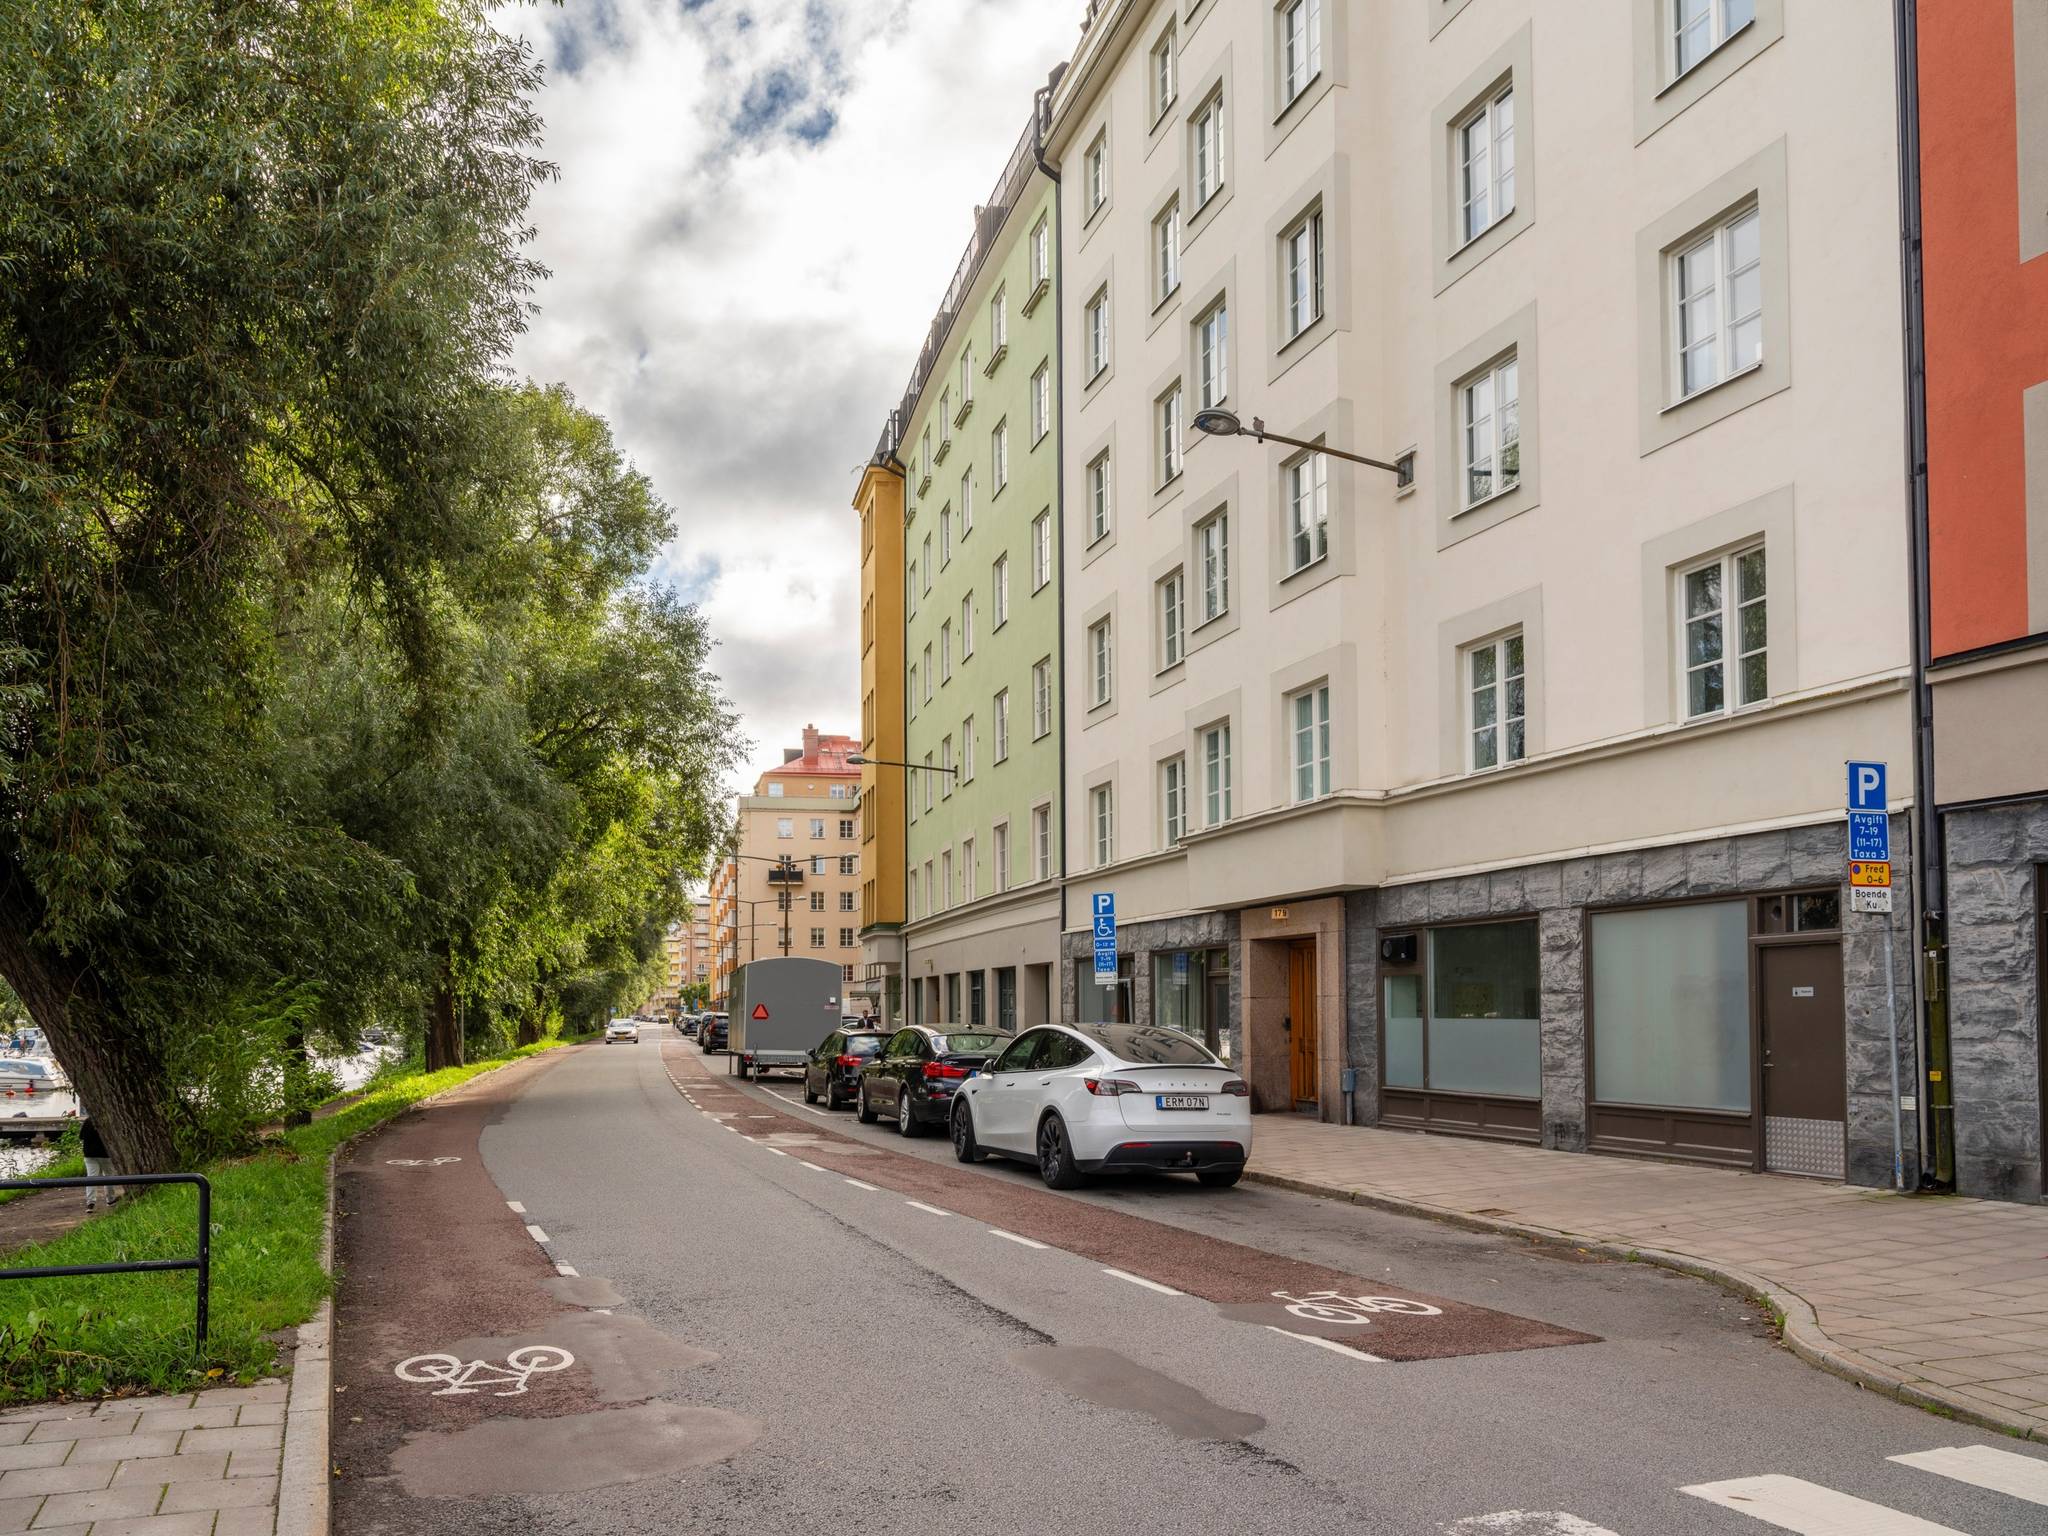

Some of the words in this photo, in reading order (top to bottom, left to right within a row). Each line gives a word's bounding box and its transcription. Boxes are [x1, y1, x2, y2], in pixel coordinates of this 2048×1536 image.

[1858, 767, 1880, 806] P
[1854, 814, 1883, 826] Avgift
[1859, 826, 1879, 836] 7-19
[1856, 837, 1883, 848] (11-17)
[1853, 849, 1877, 858] Taxa
[1880, 850, 1886, 859] 3
[1865, 864, 1884, 873] Fred
[1866, 875, 1884, 884] 0-6
[1855, 889, 1887, 899] Boende
[1098, 895, 1111, 914] P
[1165, 1097, 1184, 1107] ERM
[1186, 1097, 1205, 1107] 07N
